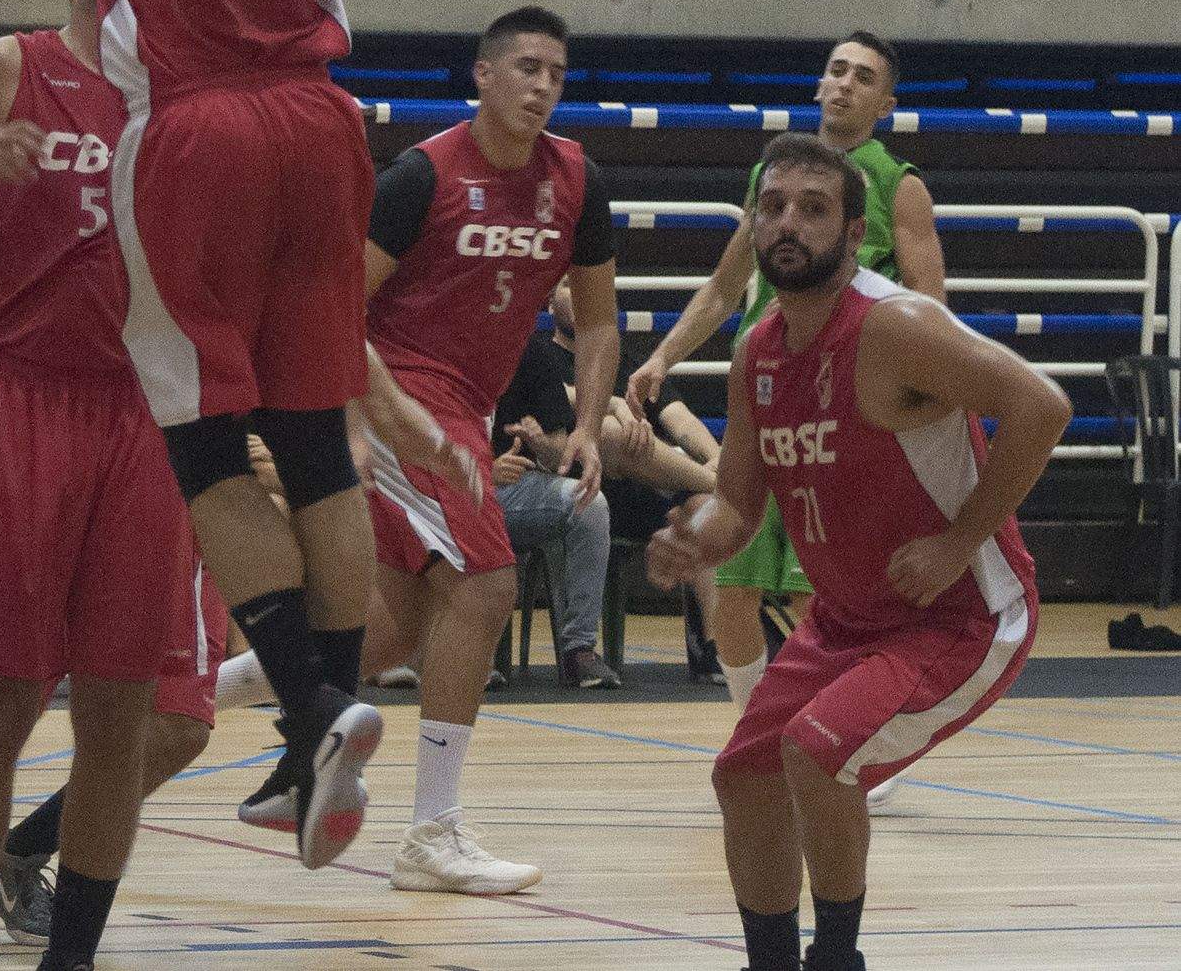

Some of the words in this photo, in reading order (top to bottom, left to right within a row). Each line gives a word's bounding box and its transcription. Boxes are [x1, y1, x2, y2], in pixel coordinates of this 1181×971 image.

[38, 131, 113, 174] CB
[78, 186, 108, 239] 5
[456, 224, 562, 261] CBSC
[488, 270, 516, 314] 5
[759, 419, 839, 467] CBSC
